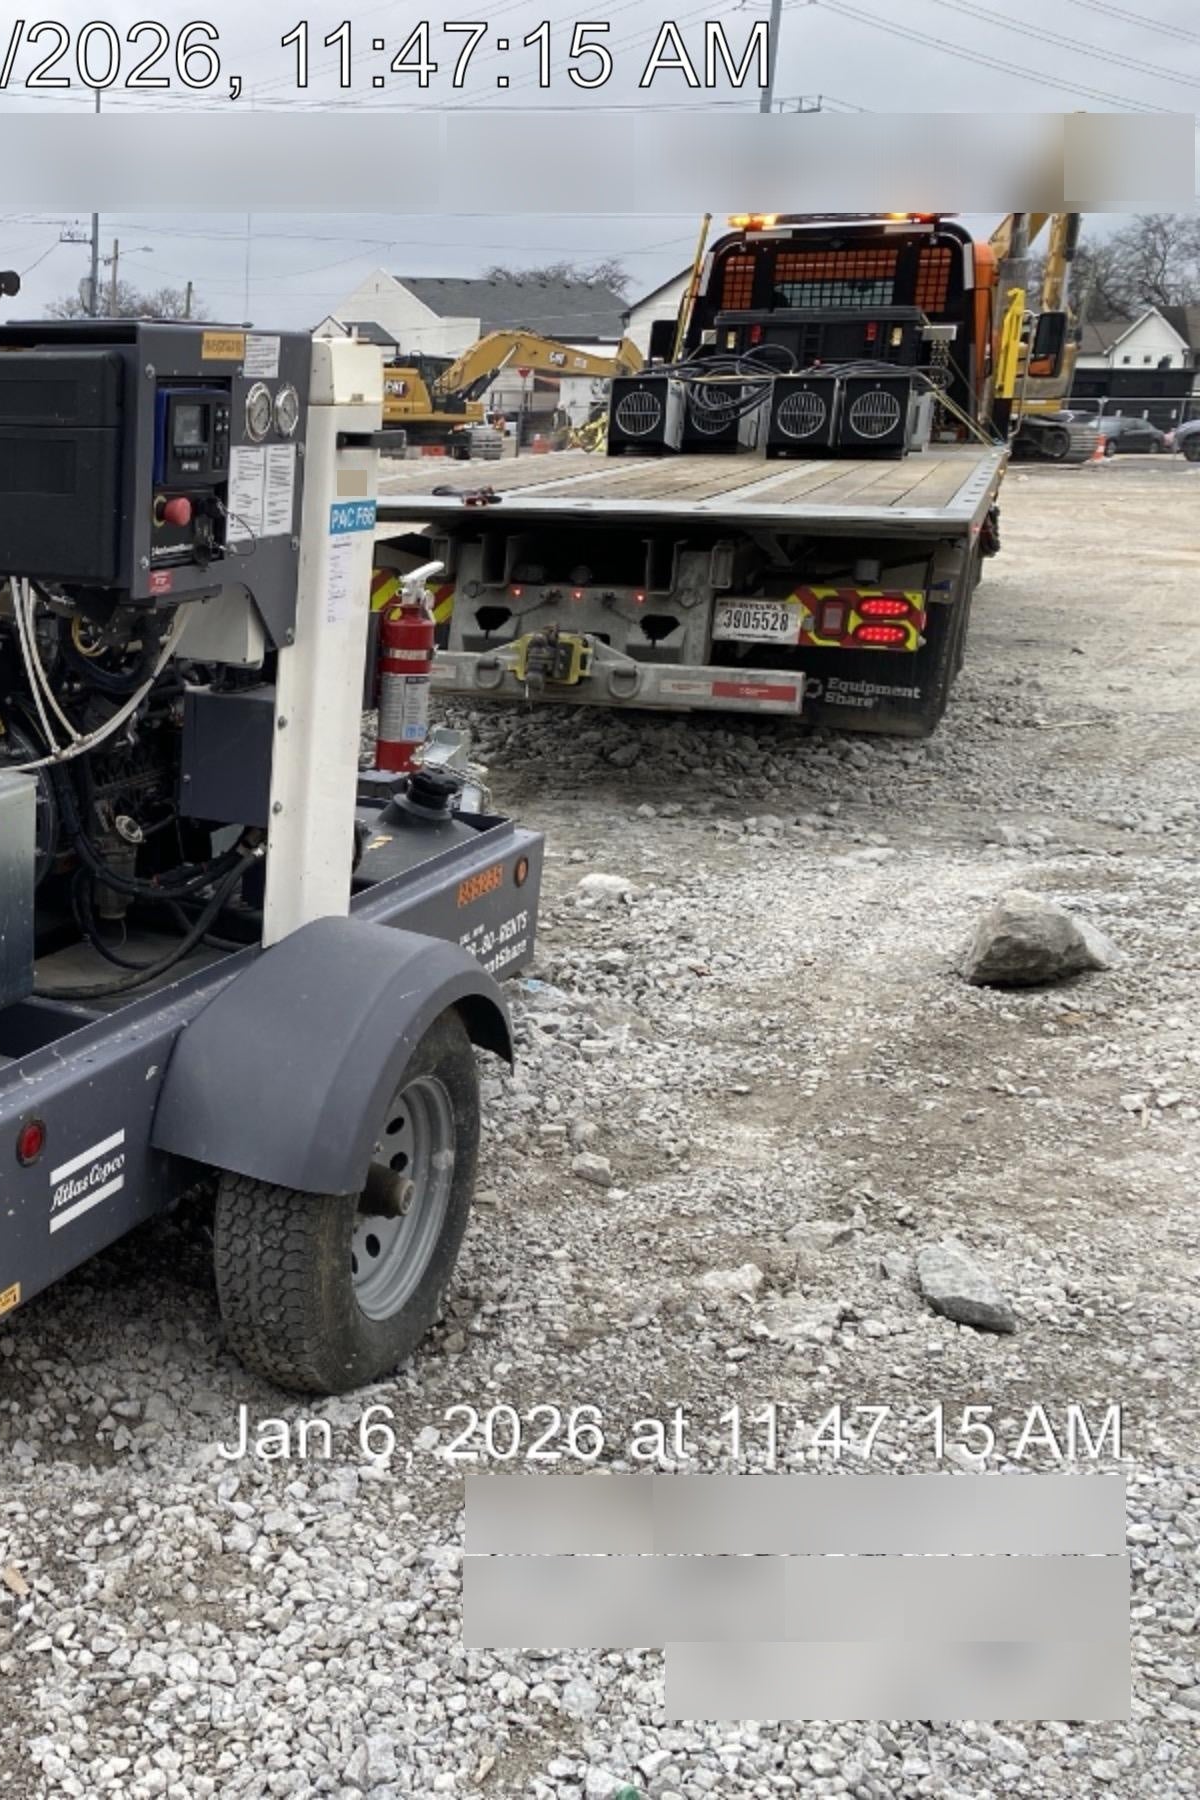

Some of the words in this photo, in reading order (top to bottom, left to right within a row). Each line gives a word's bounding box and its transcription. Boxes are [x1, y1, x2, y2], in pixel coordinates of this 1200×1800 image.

[331, 507, 354, 529] PAC
[723, 609, 789, 632] 3905528
[827, 677, 921, 700] Equipment
[50, 1175, 88, 1213] Atlas
[90, 1153, 125, 1185] Copco
